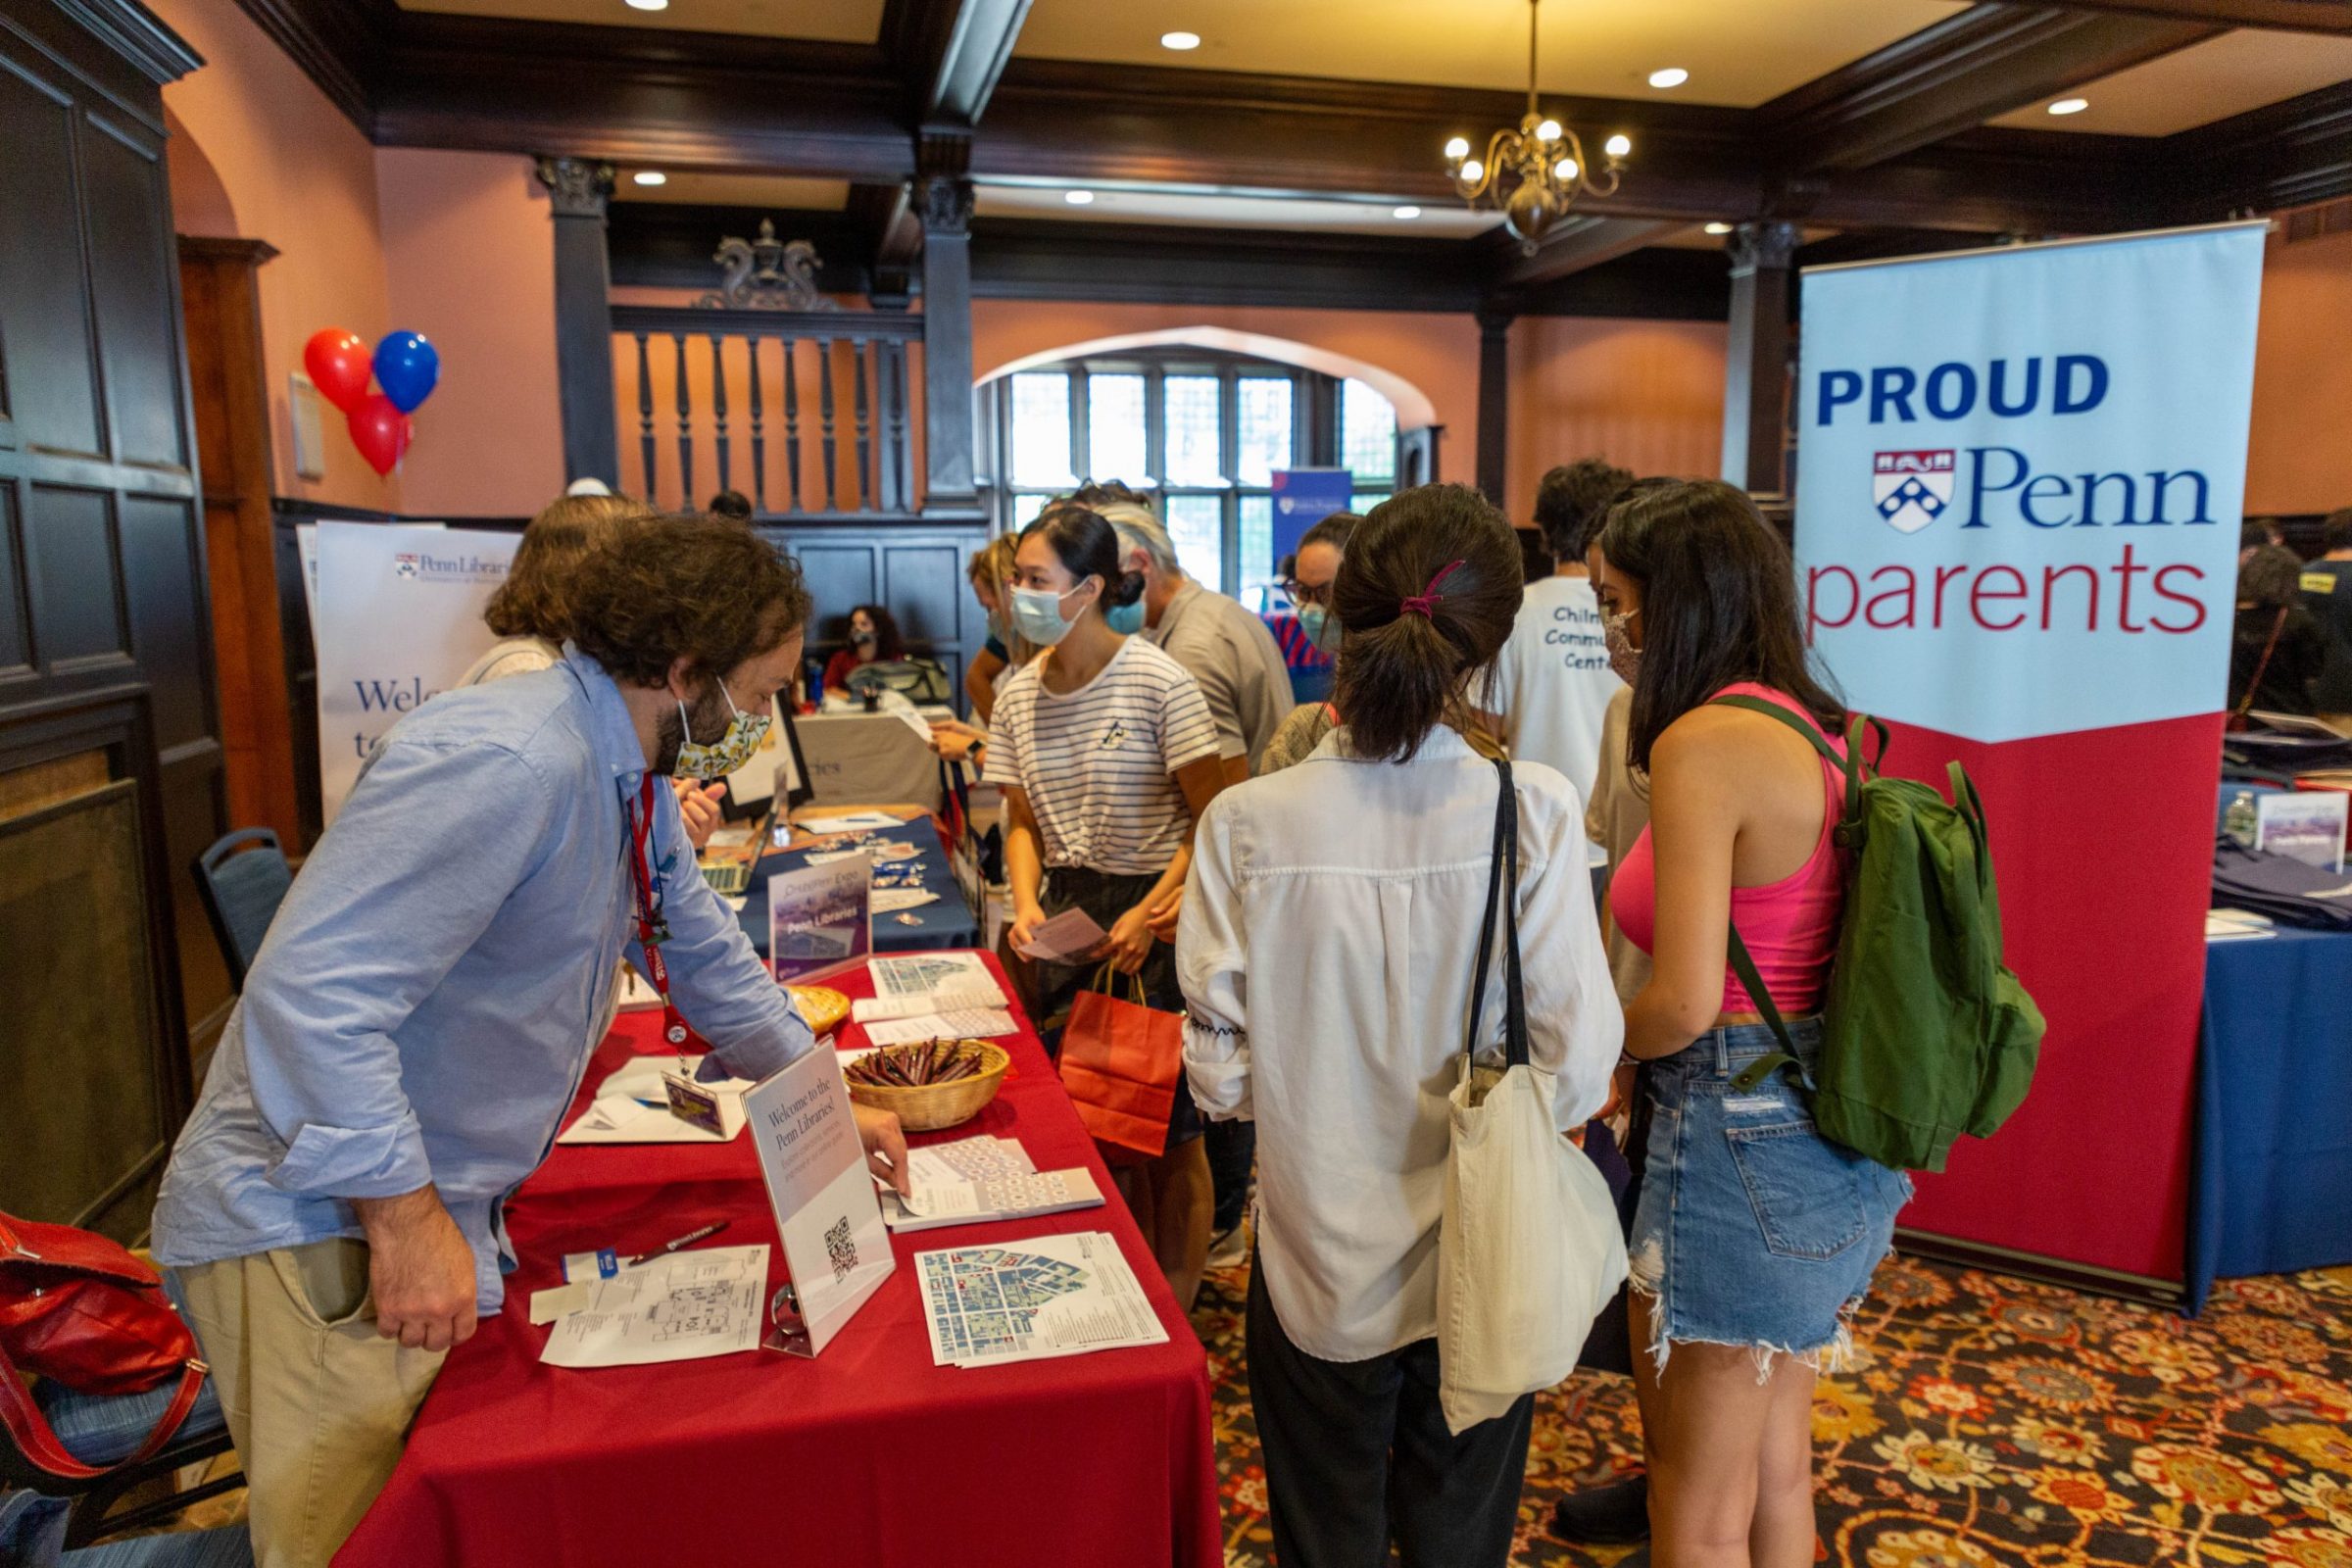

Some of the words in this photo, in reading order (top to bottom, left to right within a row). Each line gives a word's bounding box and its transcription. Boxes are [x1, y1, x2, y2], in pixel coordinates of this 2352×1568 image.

[1817, 355, 2109, 426] PROUD
[1959, 446, 2217, 529] Penn
[419, 555, 458, 572] Penn
[1804, 543, 2208, 649] parents
[768, 1096, 809, 1128] Welcome
[808, 1089, 818, 1102] to
[816, 1077, 831, 1095] the
[775, 1128, 800, 1152] Penn
